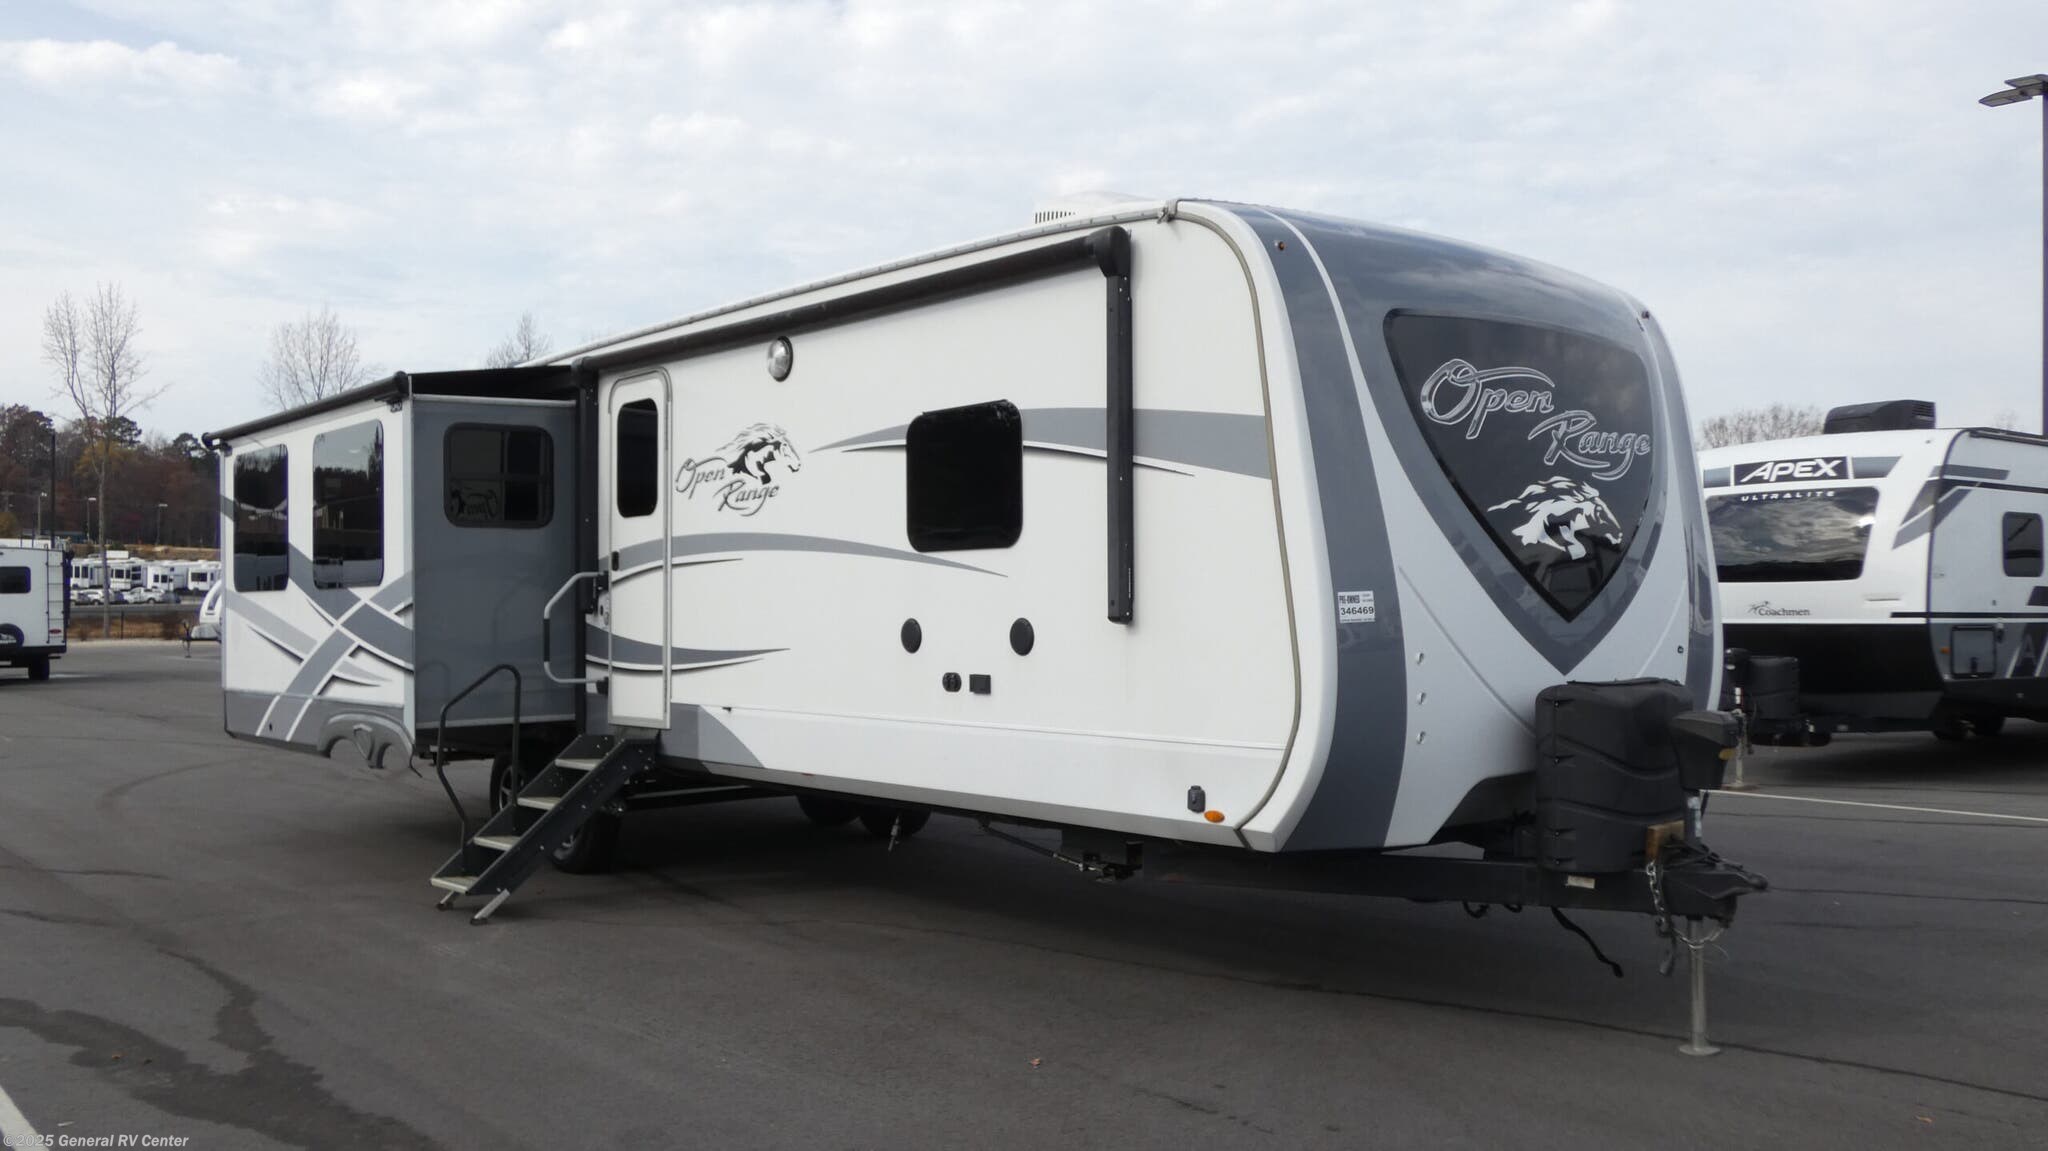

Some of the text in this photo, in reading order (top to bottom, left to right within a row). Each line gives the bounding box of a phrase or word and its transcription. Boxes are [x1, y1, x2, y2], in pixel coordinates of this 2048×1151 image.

[1420, 358, 1555, 439] Open
[1528, 410, 1651, 480] Range
[675, 457, 728, 500] Open
[1740, 458, 1843, 483] APEX
[712, 479, 779, 517] Range
[1740, 490, 1836, 502] ULTRALITE
[1340, 606, 1375, 616] 346469
[1758, 607, 1810, 617] Coachmen
